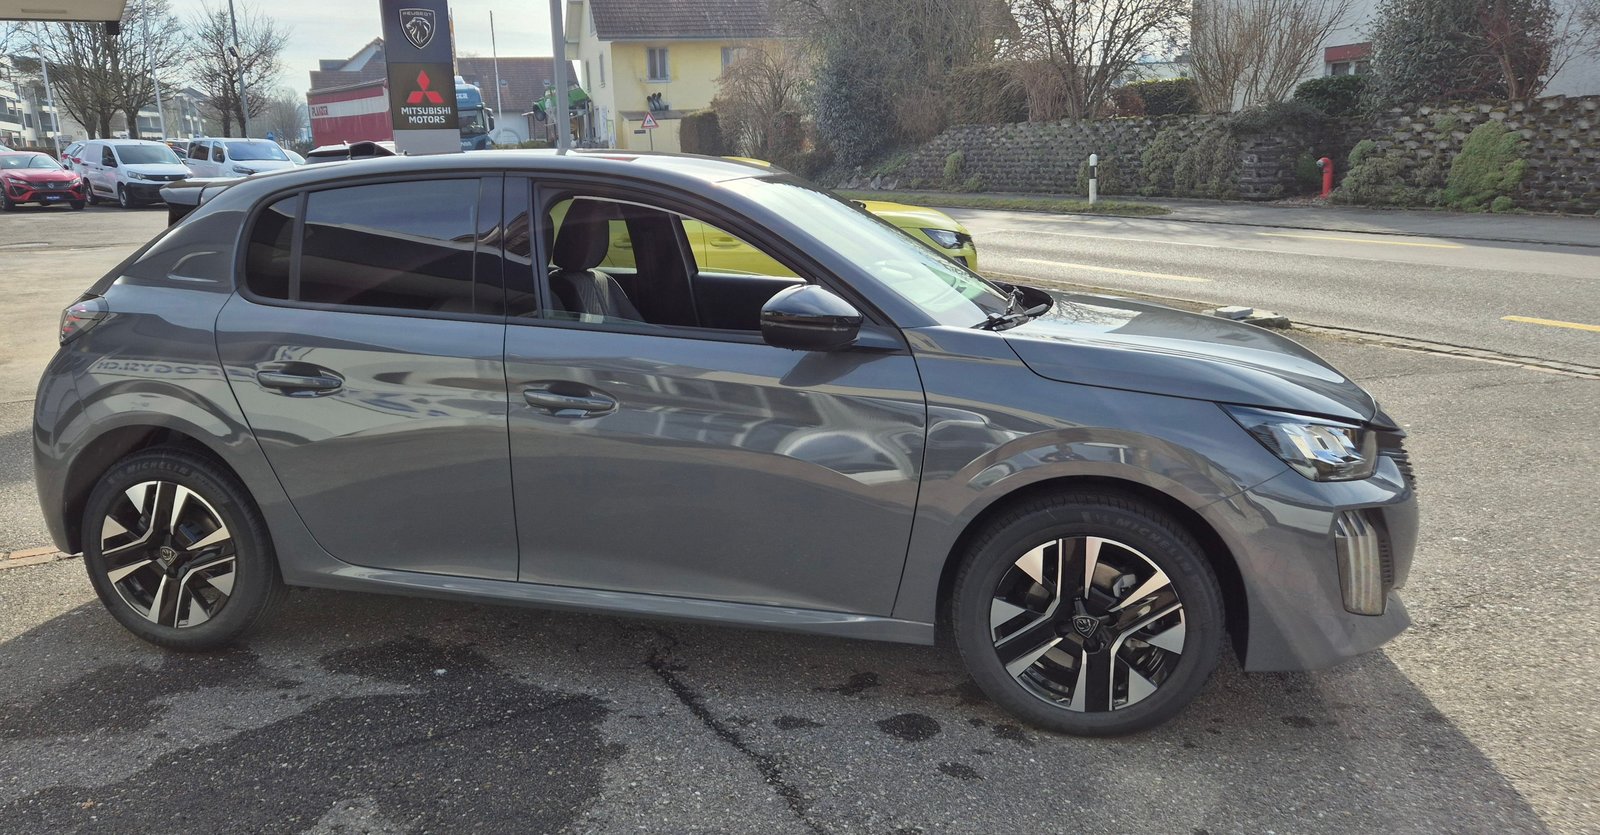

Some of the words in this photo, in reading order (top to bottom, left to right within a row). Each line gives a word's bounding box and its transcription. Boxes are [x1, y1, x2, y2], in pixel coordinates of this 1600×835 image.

[400, 106, 451, 115] MITSUBISHI
[408, 115, 446, 124] MOTORS
[127, 461, 190, 475] MICHELIN
[1116, 518, 1192, 571] MICHELIN
